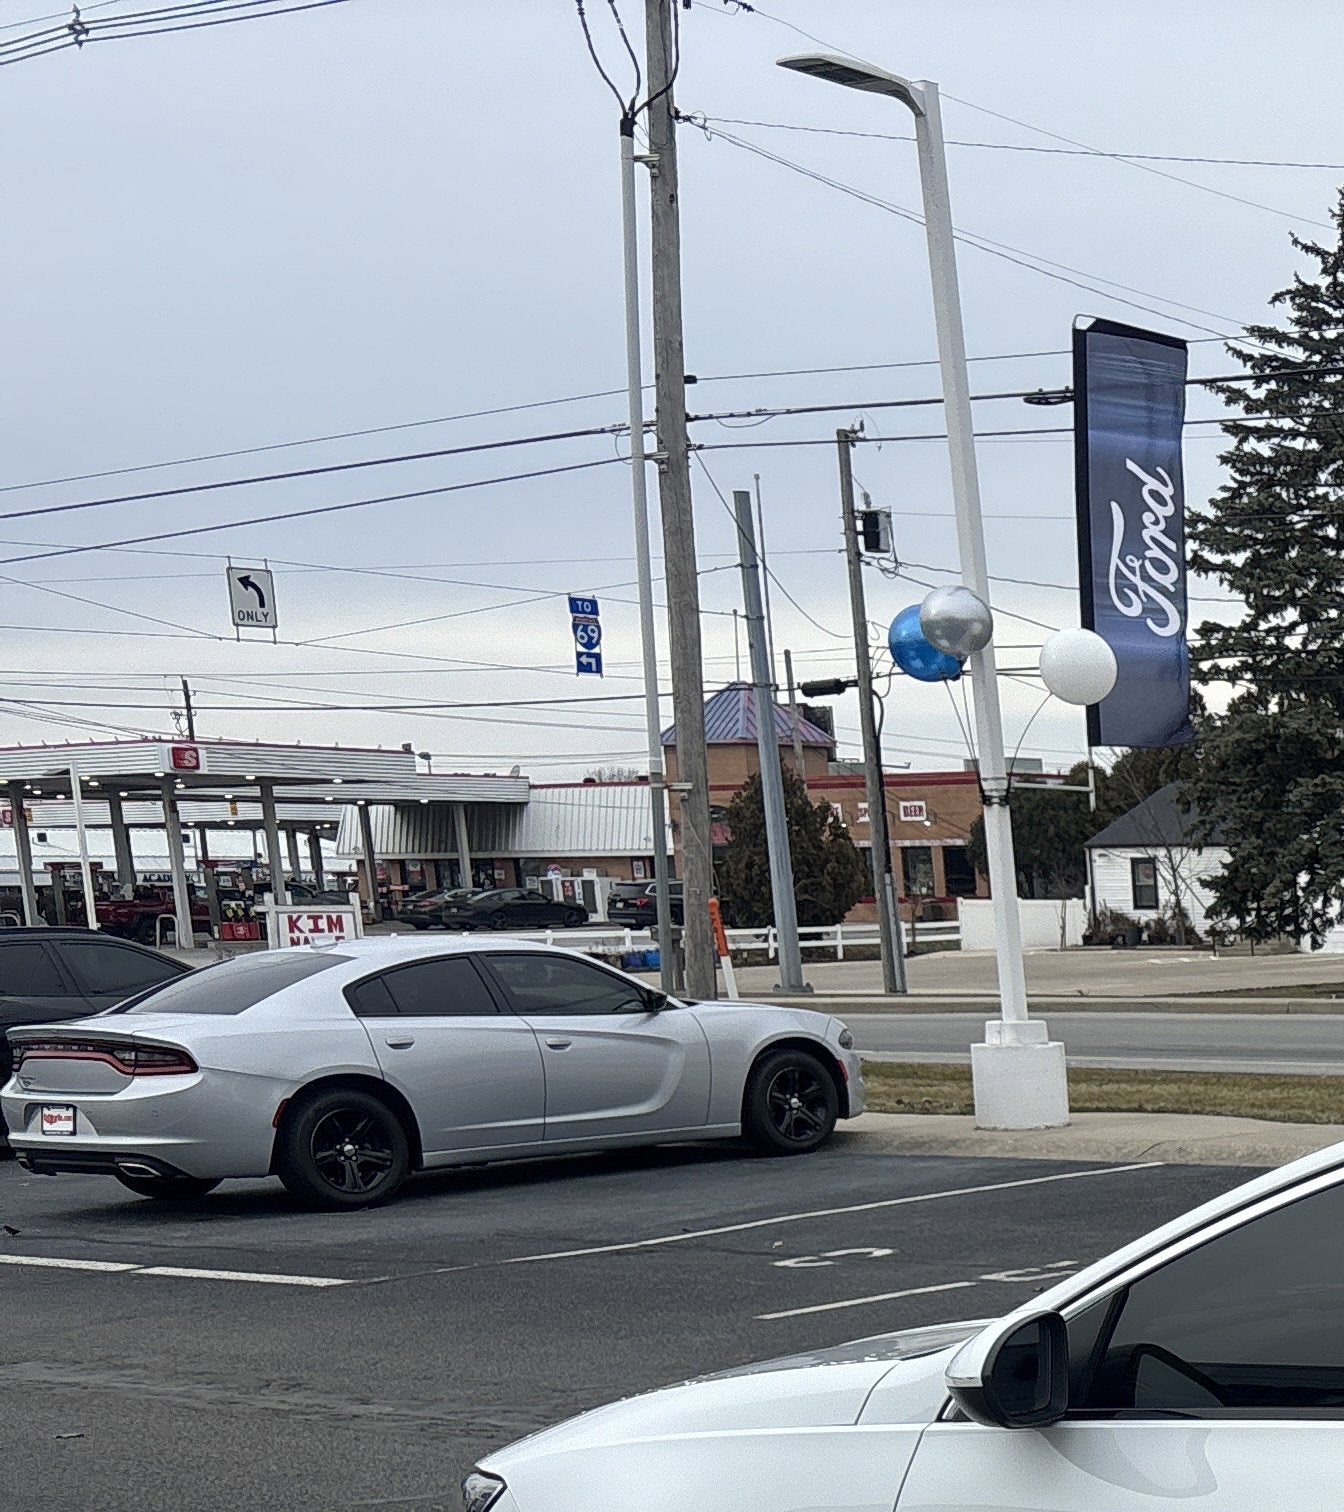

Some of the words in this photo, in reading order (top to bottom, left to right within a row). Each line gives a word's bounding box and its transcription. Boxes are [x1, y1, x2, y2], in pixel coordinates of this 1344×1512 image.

[1109, 458, 1181, 637] Ford
[237, 609, 270, 623] ONLY
[576, 601, 592, 613] TO
[577, 625, 599, 644] 69
[287, 914, 345, 934] KIM
